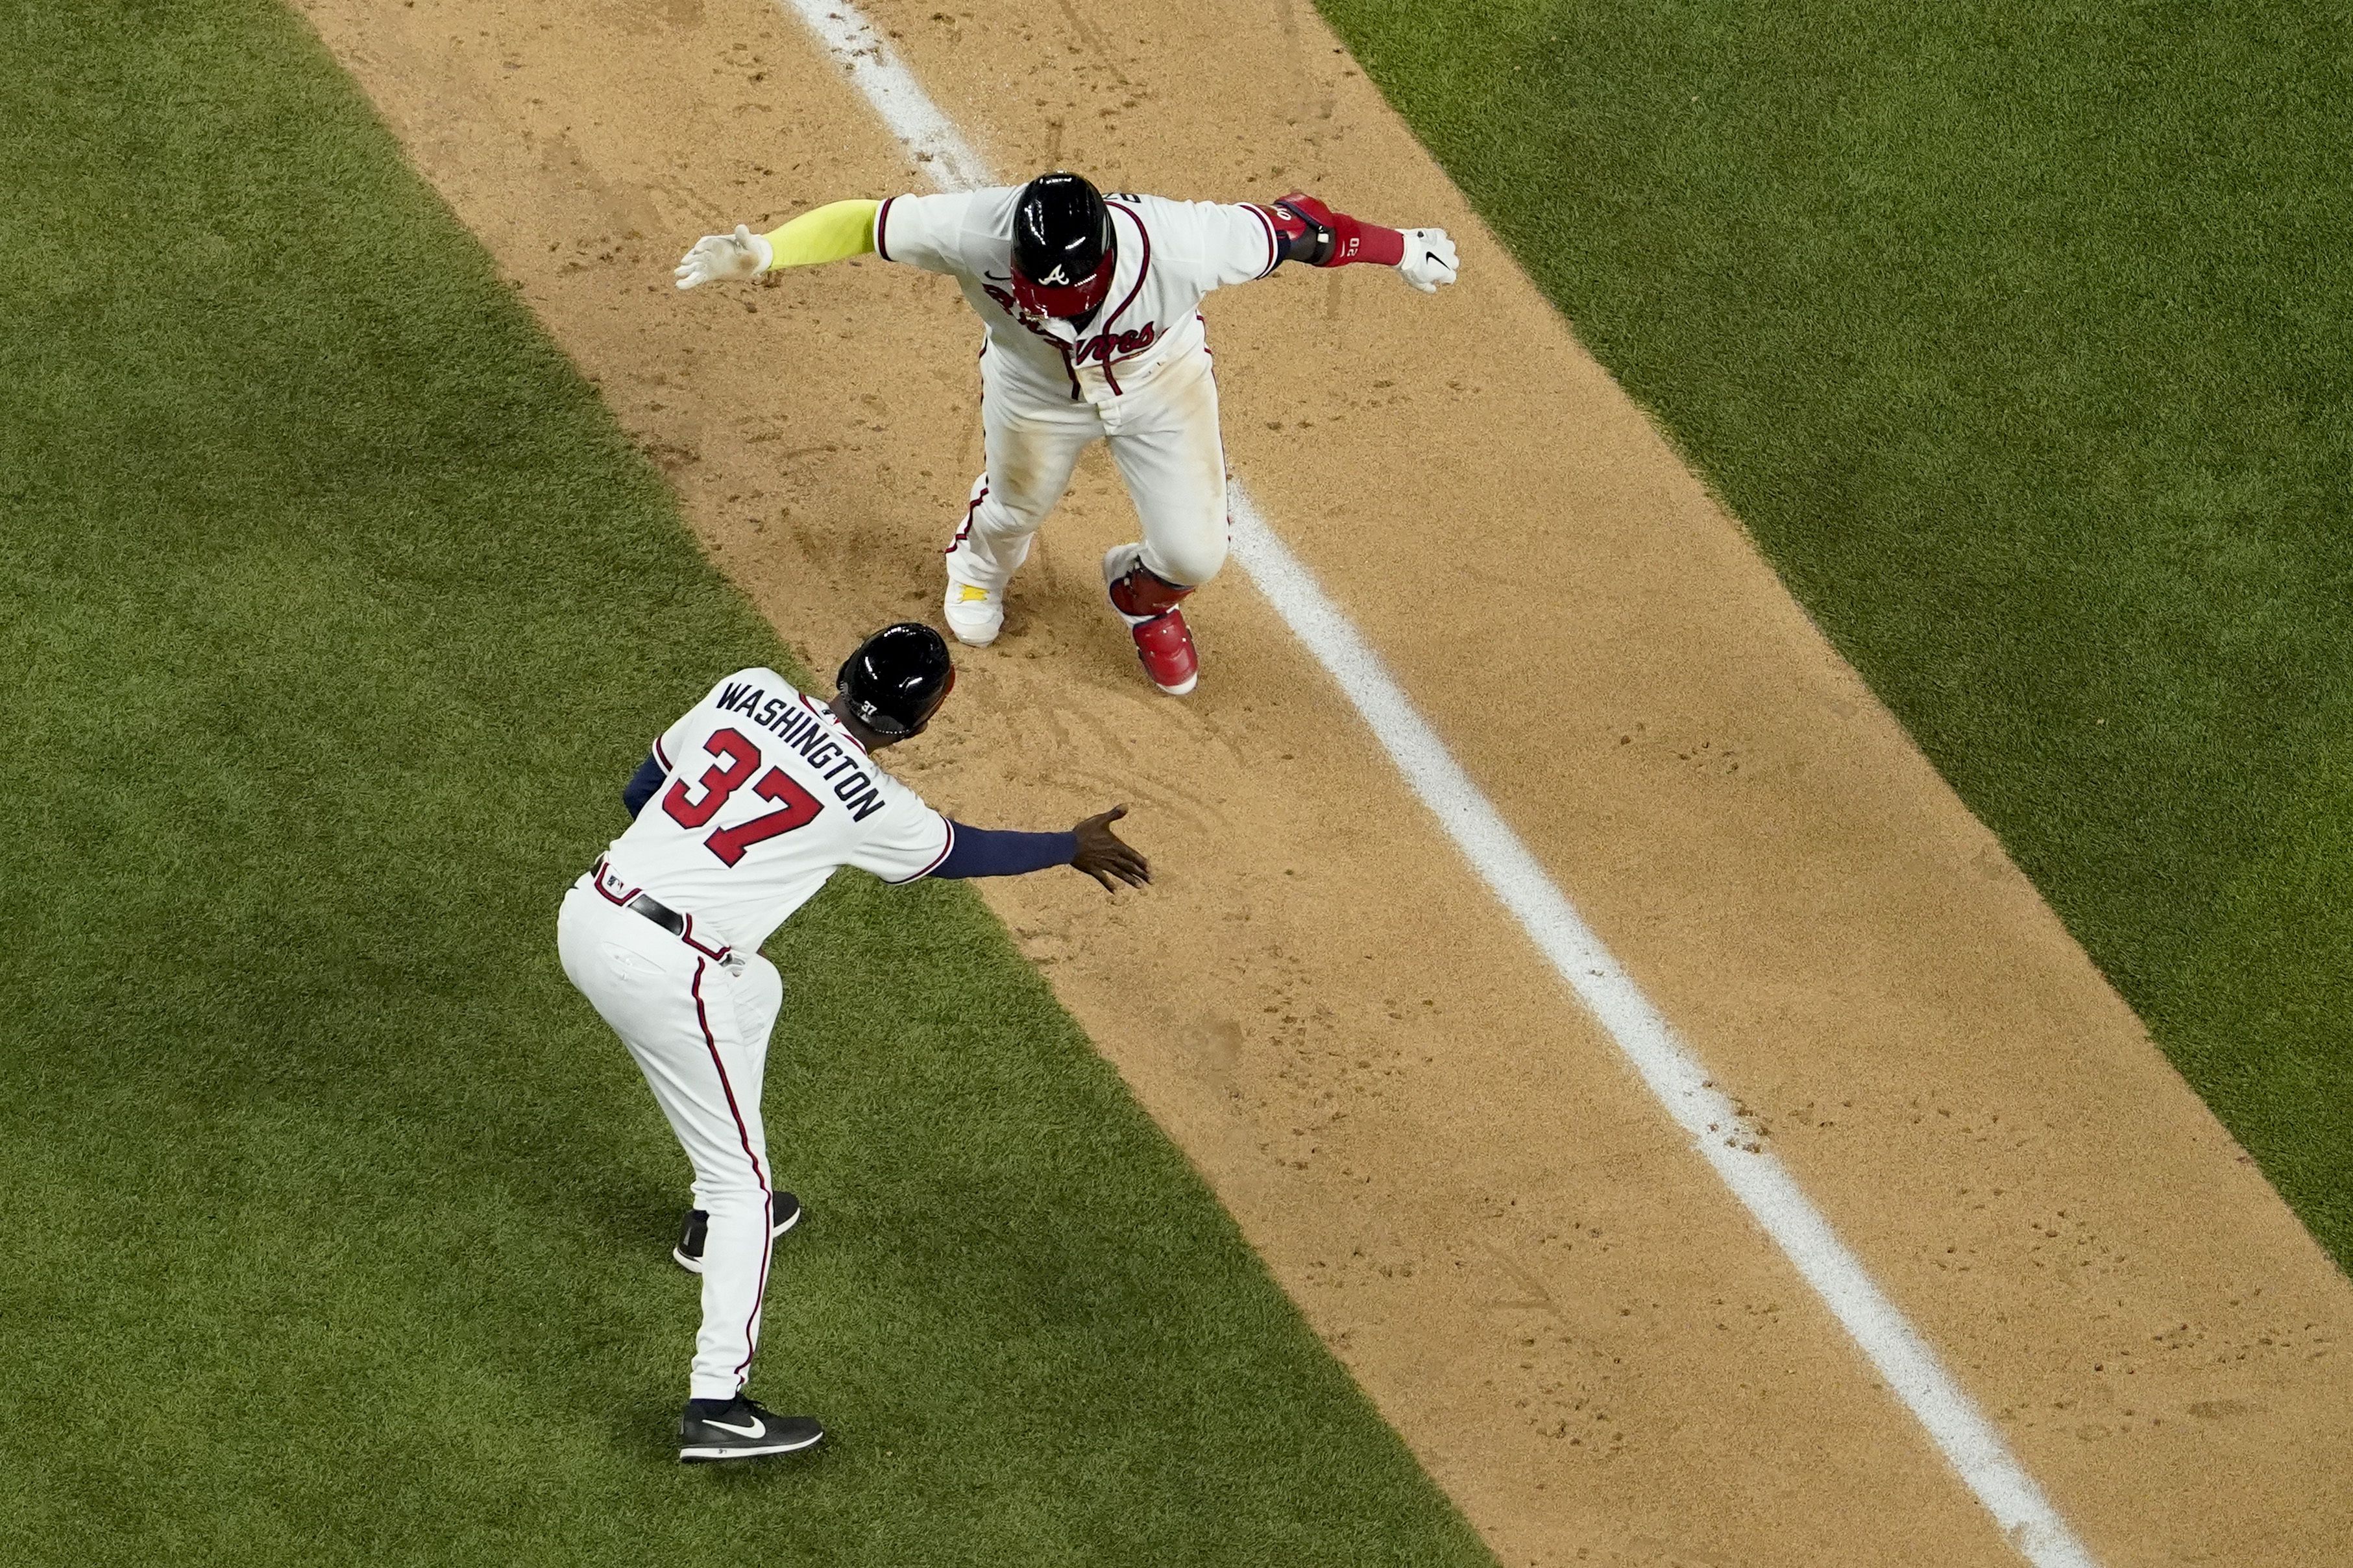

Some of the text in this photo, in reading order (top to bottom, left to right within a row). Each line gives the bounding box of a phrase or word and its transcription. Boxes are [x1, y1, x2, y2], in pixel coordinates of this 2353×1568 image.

[1347, 237, 1360, 257] 20
[1038, 263, 1070, 285] A
[861, 700, 877, 716] 37
[716, 682, 886, 823] WASHINGTON
[661, 727, 825, 869] 37
